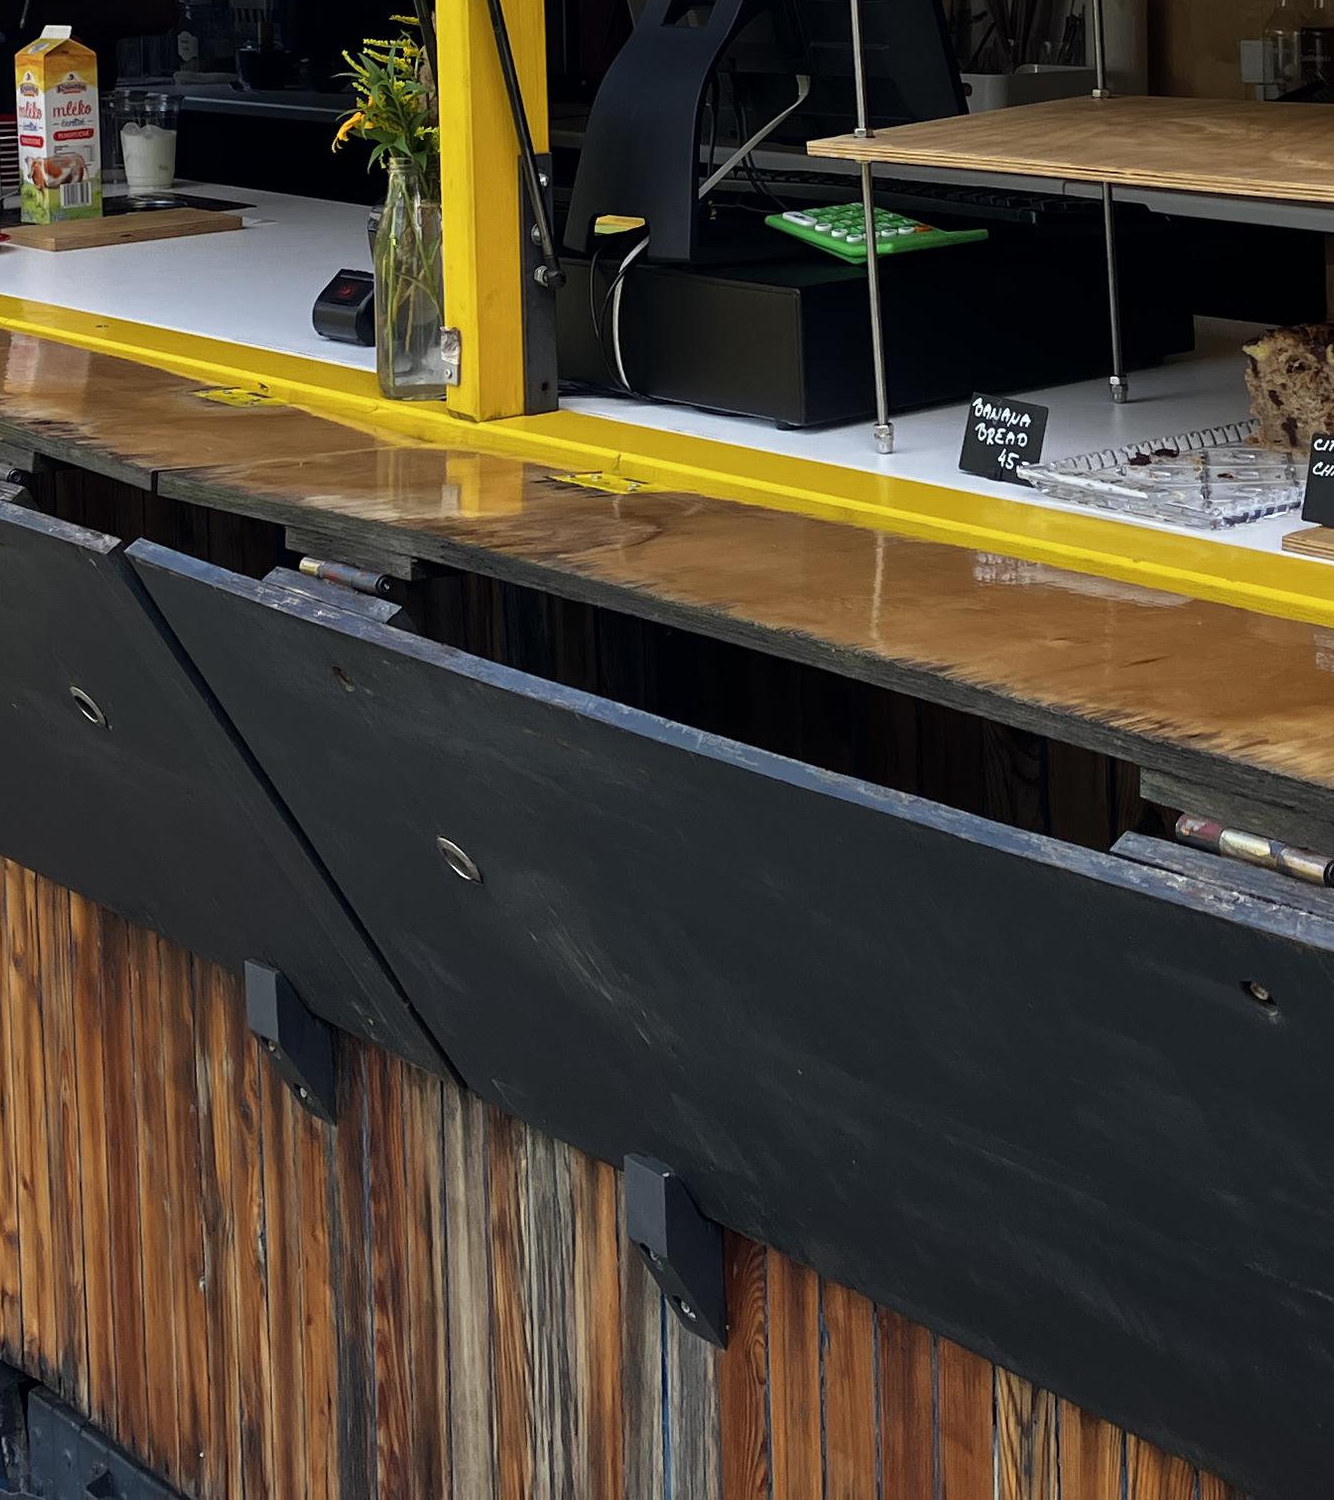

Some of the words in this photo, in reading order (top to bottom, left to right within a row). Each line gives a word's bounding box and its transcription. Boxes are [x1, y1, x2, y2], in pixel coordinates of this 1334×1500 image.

[52, 99, 92, 119] mléko
[972, 397, 1032, 428] BANANA
[974, 422, 1028, 448] BREAD
